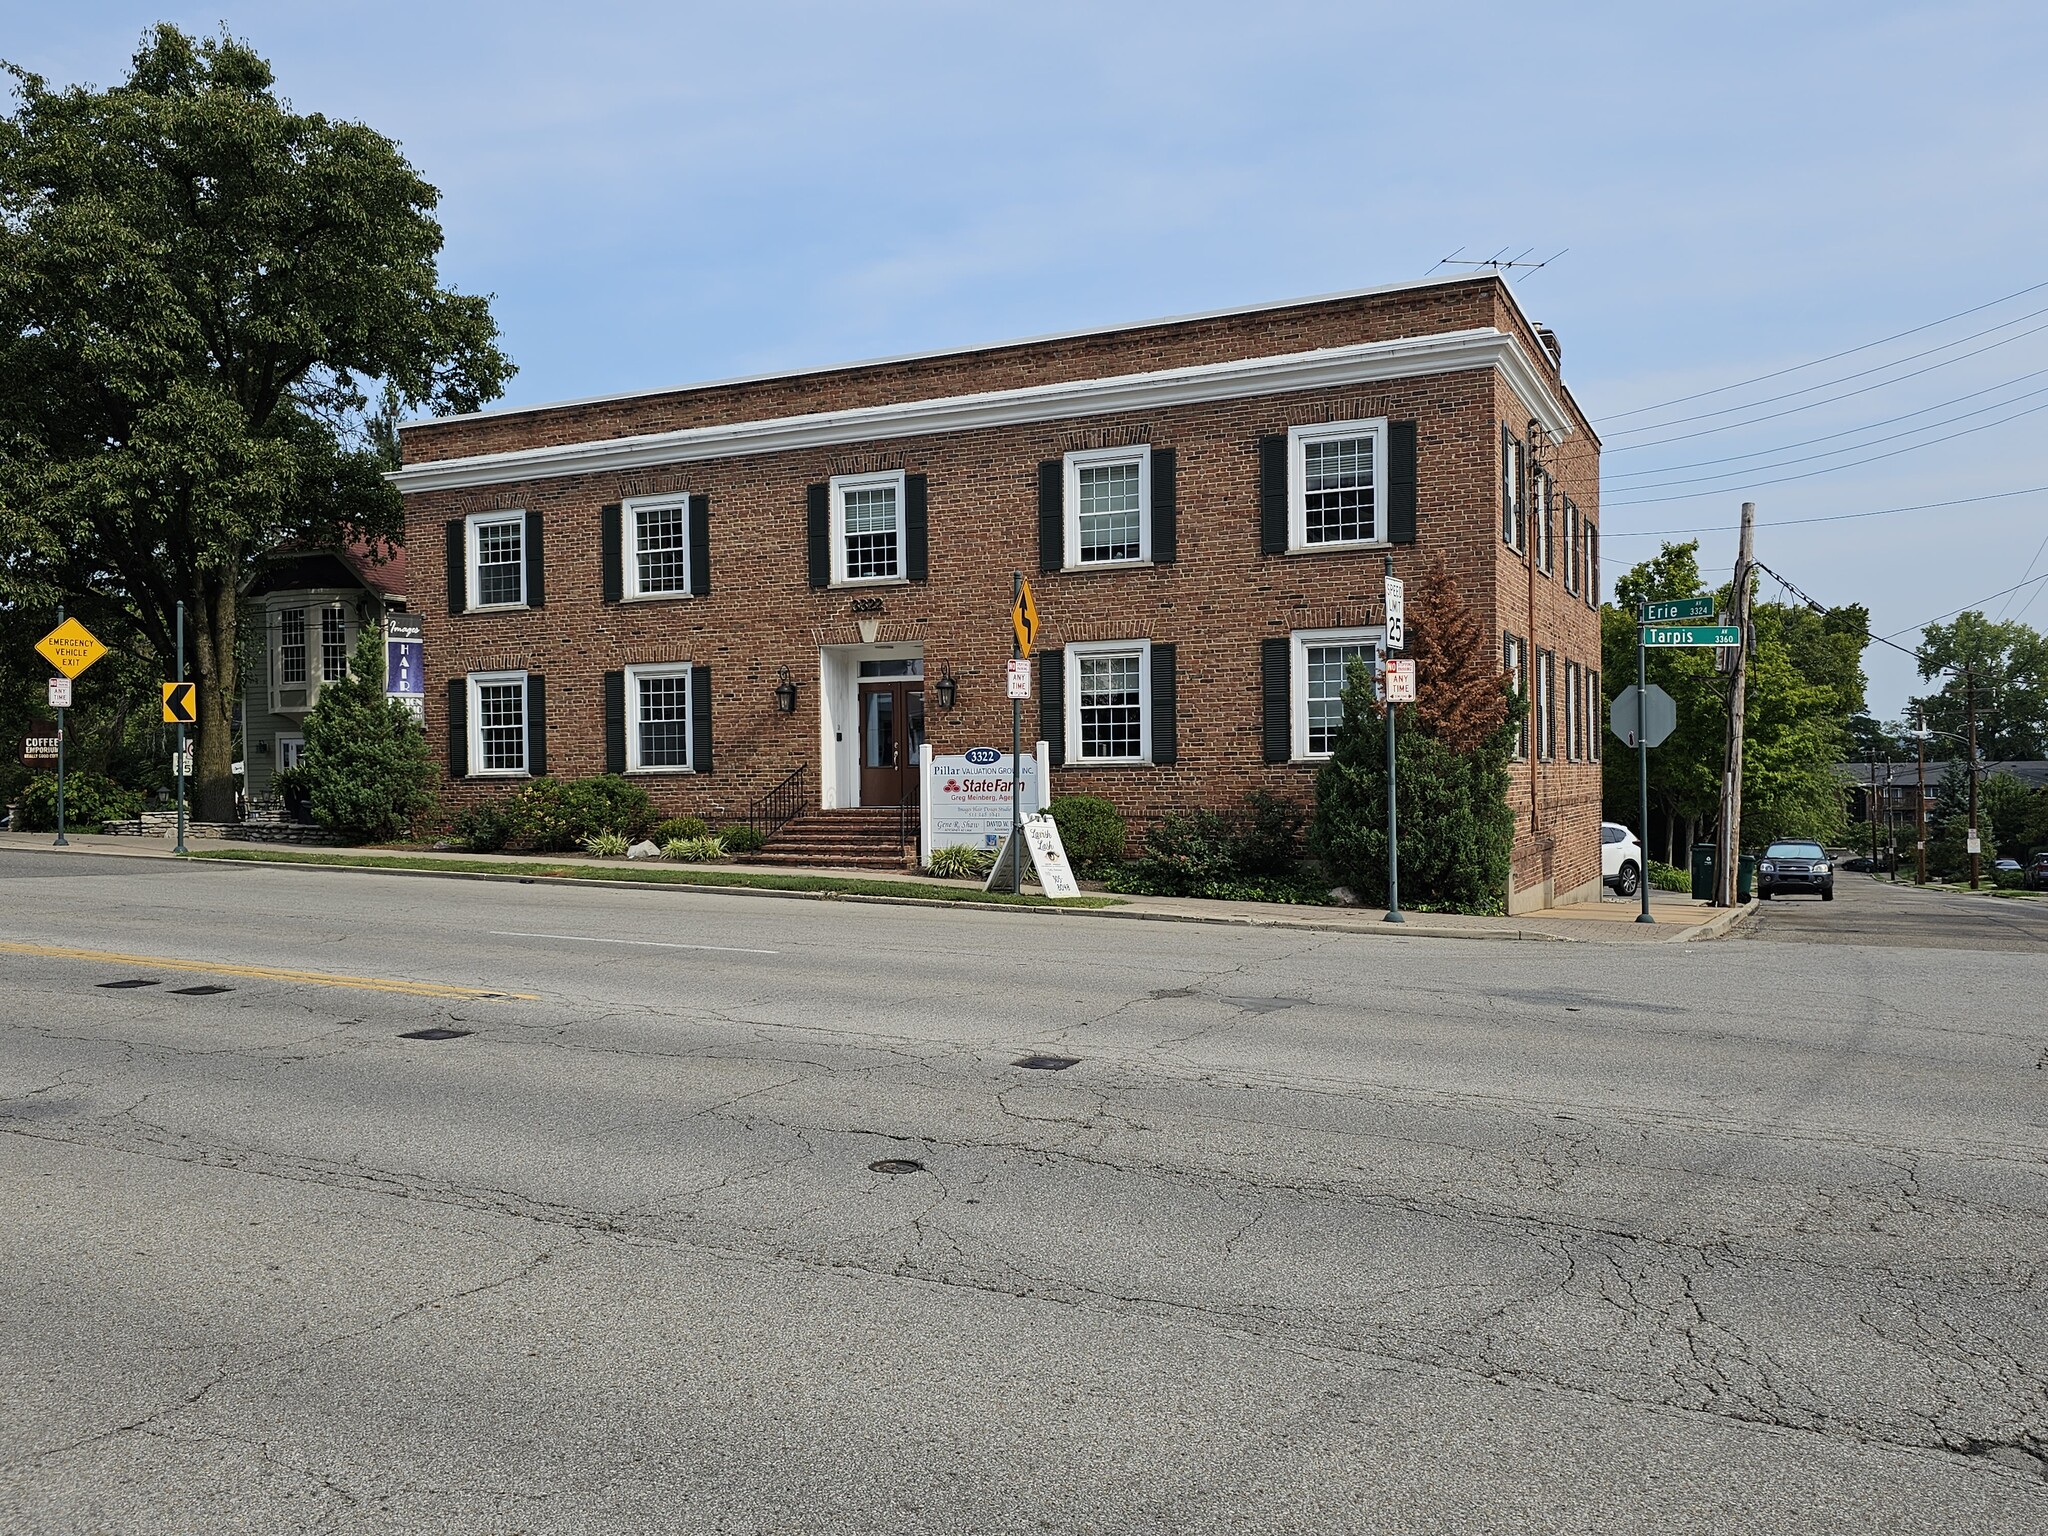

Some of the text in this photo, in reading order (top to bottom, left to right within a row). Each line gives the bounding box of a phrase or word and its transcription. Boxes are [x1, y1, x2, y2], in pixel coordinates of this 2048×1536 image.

[1387, 583, 1402, 598] SPEED
[852, 597, 883, 612] 3322
[1388, 599, 1401, 613] LIMIT
[1648, 604, 1678, 619] Erie
[1689, 606, 1708, 616] 3324
[390, 620, 420, 637] Images
[1389, 616, 1402, 642] 25
[1650, 629, 1693, 645] Tarpis
[1715, 635, 1733, 643] 3360
[48, 638, 94, 648] EMERGENCY
[55, 648, 87, 657] VEHICLE
[399, 644, 410, 691] HAIR
[1388, 662, 1396, 671] NO
[25, 738, 59, 746] COFFEE
[971, 751, 994, 762] 3322
[934, 766, 960, 775] Pillar
[961, 767, 997, 775] VALUATION
[951, 794, 966, 802] Greg
[967, 794, 997, 802] Meinberg,
[937, 820, 952, 829] Gene
[961, 820, 980, 828] Shaw
[986, 820, 1001, 828] DAVID
[1030, 828, 1052, 839] Lavish
[1037, 840, 1054, 851] Lash
